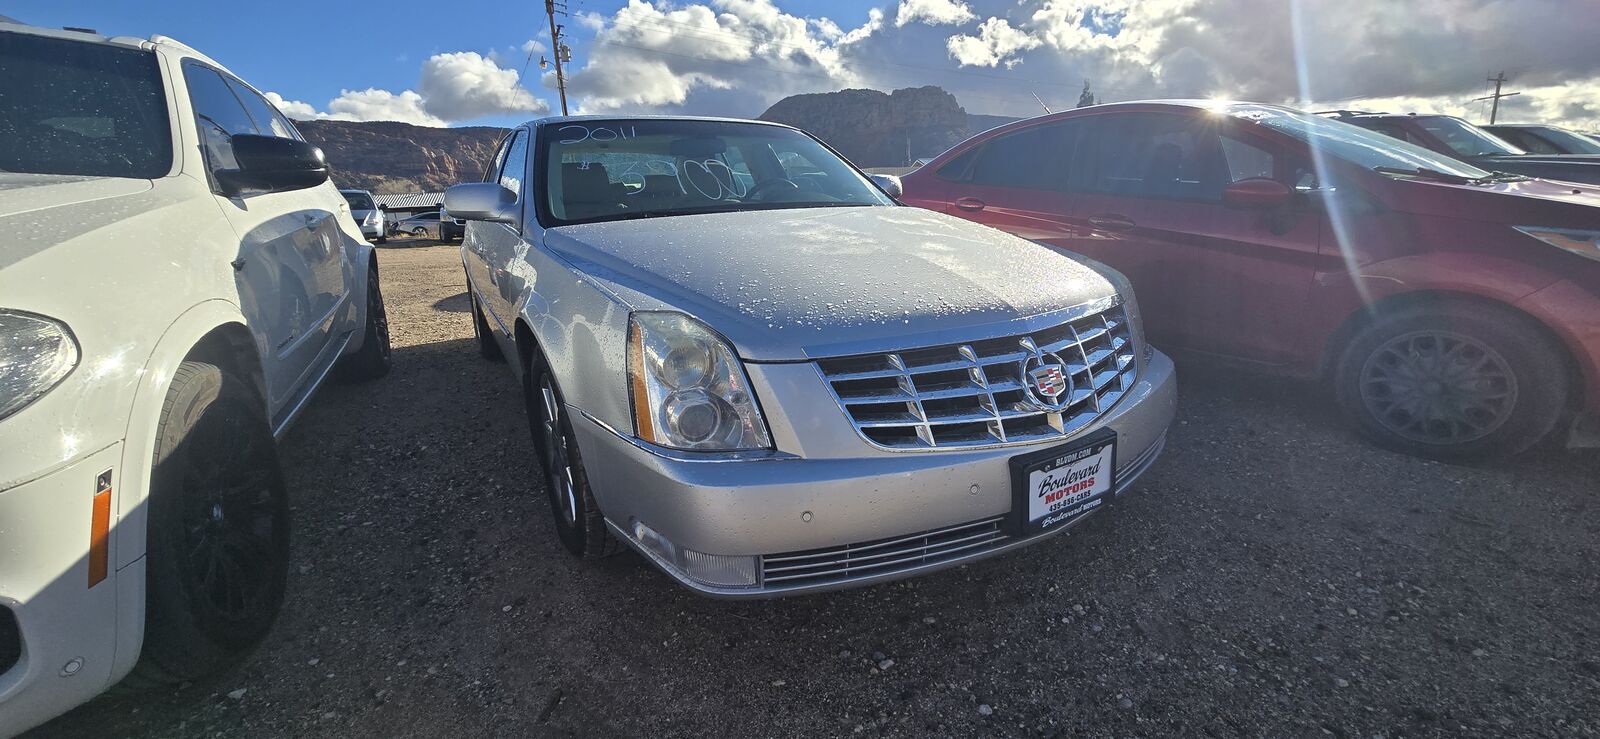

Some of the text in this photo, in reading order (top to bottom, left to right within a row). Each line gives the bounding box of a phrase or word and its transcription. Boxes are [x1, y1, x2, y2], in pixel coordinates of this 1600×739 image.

[559, 125, 636, 145] 2011
[1055, 447, 1092, 466] BLVDM.COM
[1038, 456, 1103, 498] Boulevard
[1044, 477, 1095, 504] MOTORS
[1042, 503, 1083, 528] Boulevard
